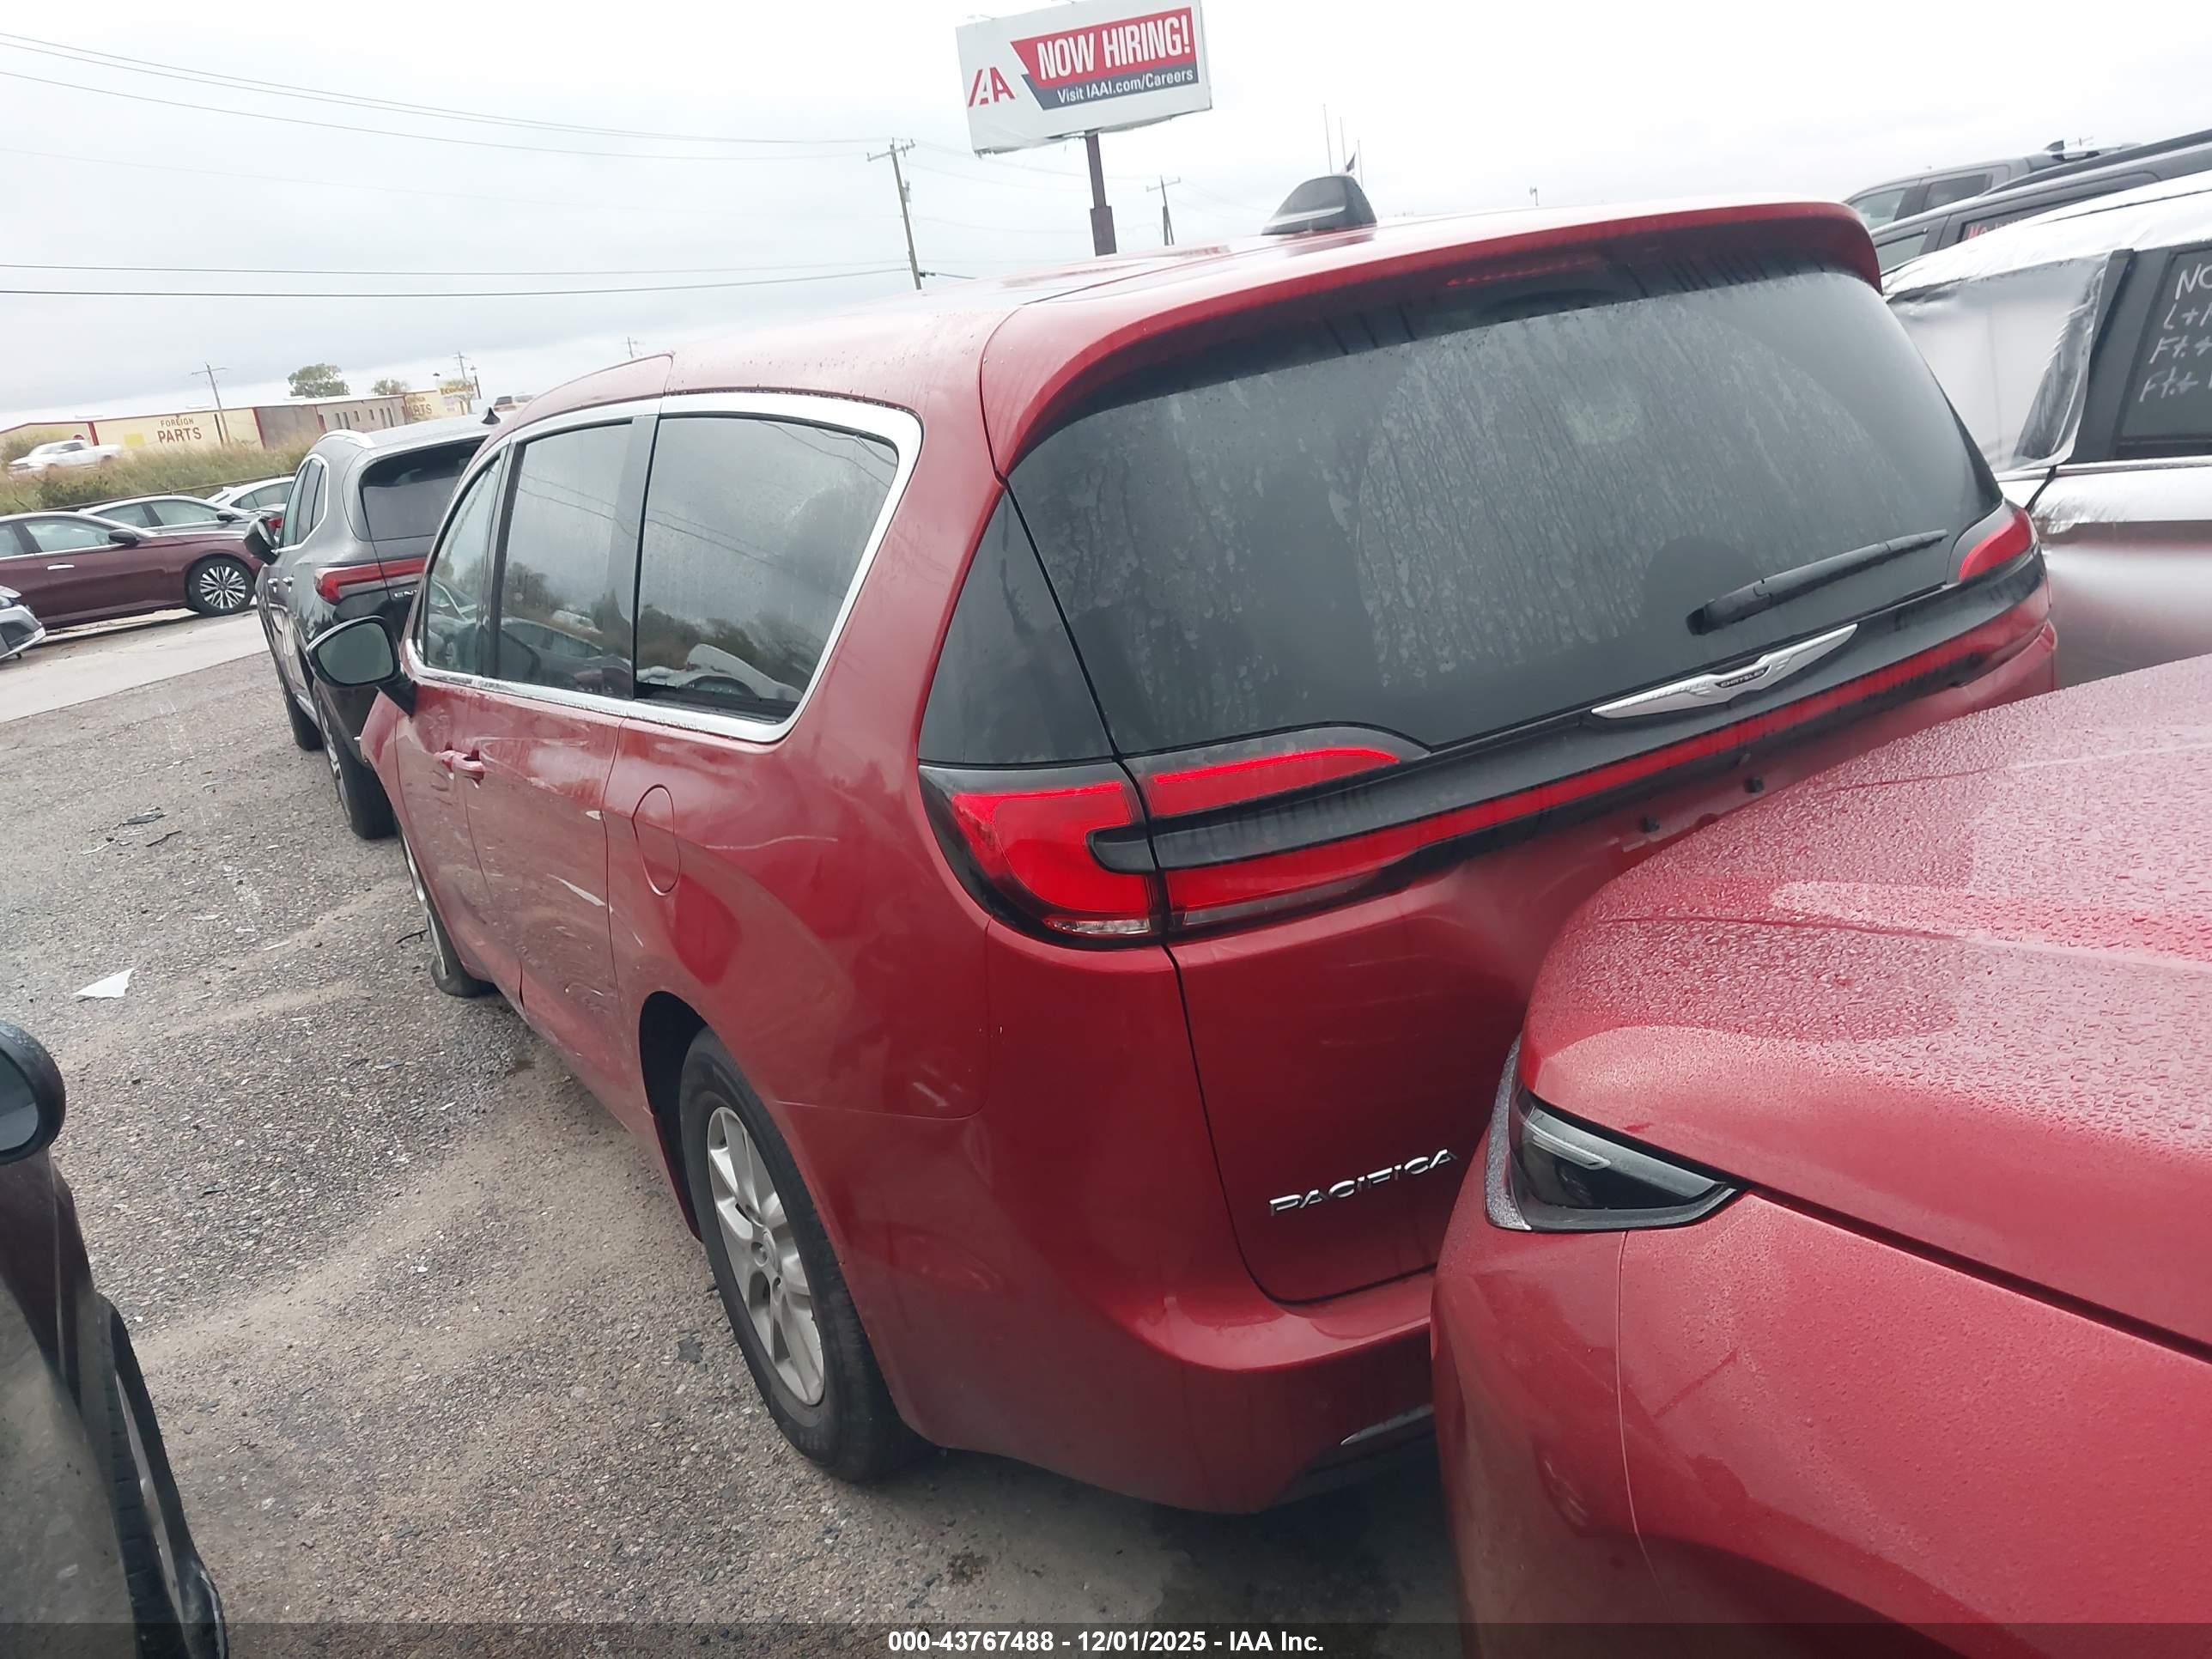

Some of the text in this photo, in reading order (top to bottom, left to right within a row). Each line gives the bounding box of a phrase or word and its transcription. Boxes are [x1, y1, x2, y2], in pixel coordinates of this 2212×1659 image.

[1036, 15, 1191, 81] NOW HIRING!
[1056, 69, 1194, 104] Visit IAAI.com/Careers
[157, 427, 203, 443] PARTS
[1269, 1148, 1458, 1217] PACIFICA
